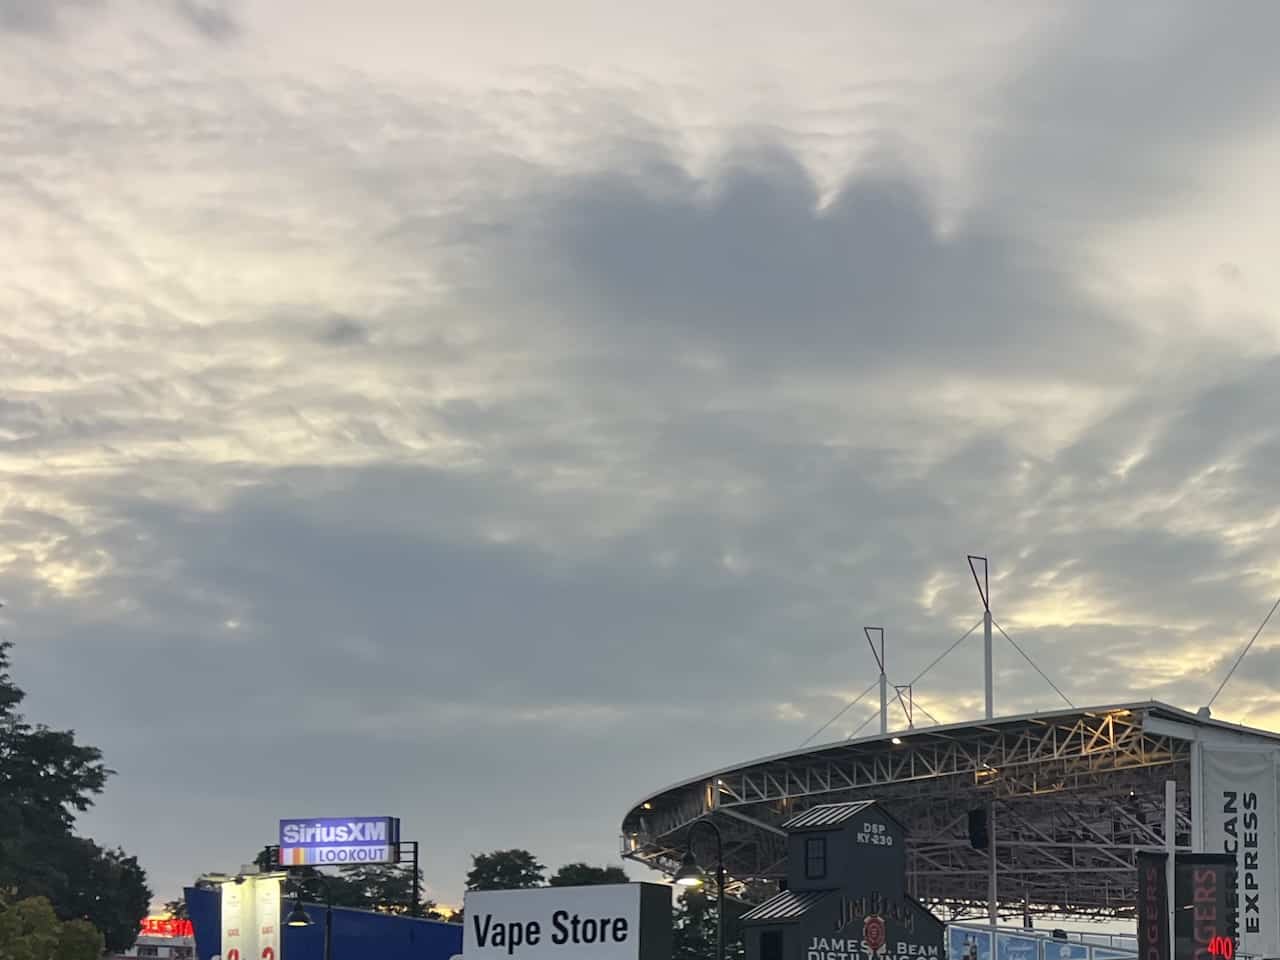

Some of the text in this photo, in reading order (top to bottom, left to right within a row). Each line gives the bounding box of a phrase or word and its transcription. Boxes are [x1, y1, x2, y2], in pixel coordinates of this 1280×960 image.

[283, 822, 386, 843] SiriusXM
[863, 822, 886, 834] DSP
[856, 833, 893, 846] KY-230
[320, 848, 385, 862] LOOKOUT
[1243, 791, 1260, 933] EXPRESS
[473, 910, 628, 955] Vape Store
[808, 937, 870, 954] JAMES
[897, 942, 938, 956] BEAM
